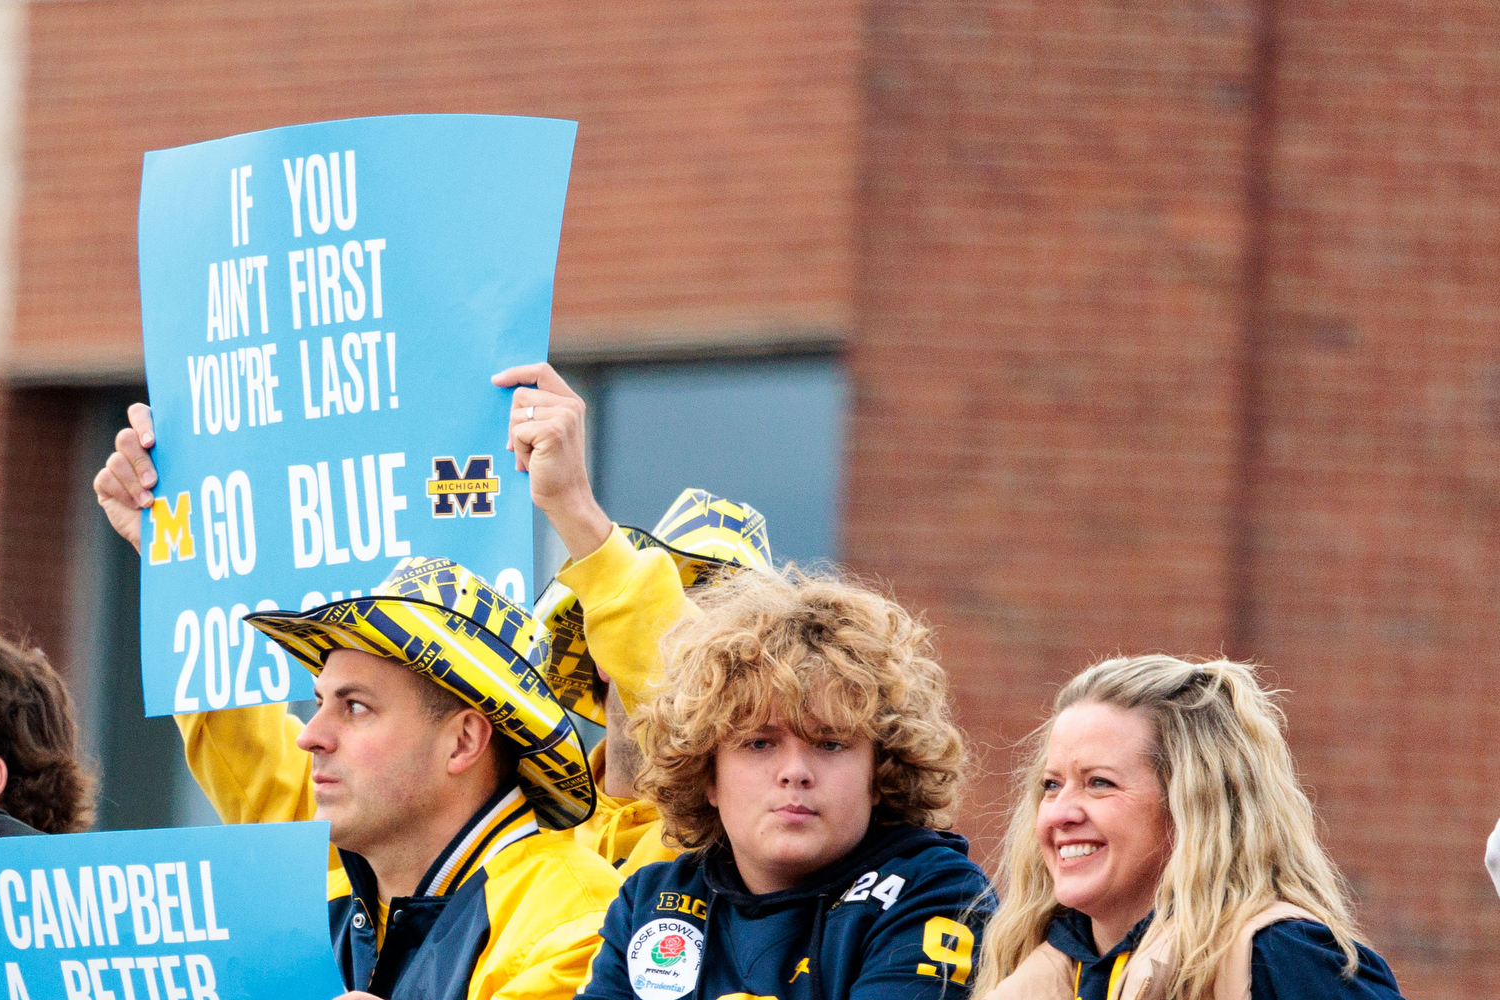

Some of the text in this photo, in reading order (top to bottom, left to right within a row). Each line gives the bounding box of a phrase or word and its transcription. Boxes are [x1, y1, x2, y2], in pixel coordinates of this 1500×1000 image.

[231, 150, 357, 247] IF YOU
[206, 238, 387, 342] AIN'T FIRST
[187, 332, 399, 435] YOU'RE LAST!
[201, 452, 411, 580] GO BLUE
[437, 482, 489, 491] MICHIGAN
[395, 558, 450, 583] MICHIGAN
[174, 599, 291, 712] 2023
[0, 860, 229, 949] CAMPBELL
[631, 922, 694, 960] ROSE BOWL
[644, 967, 672, 976] presented
[645, 981, 686, 993] Prudential
[916, 915, 975, 985] 9
